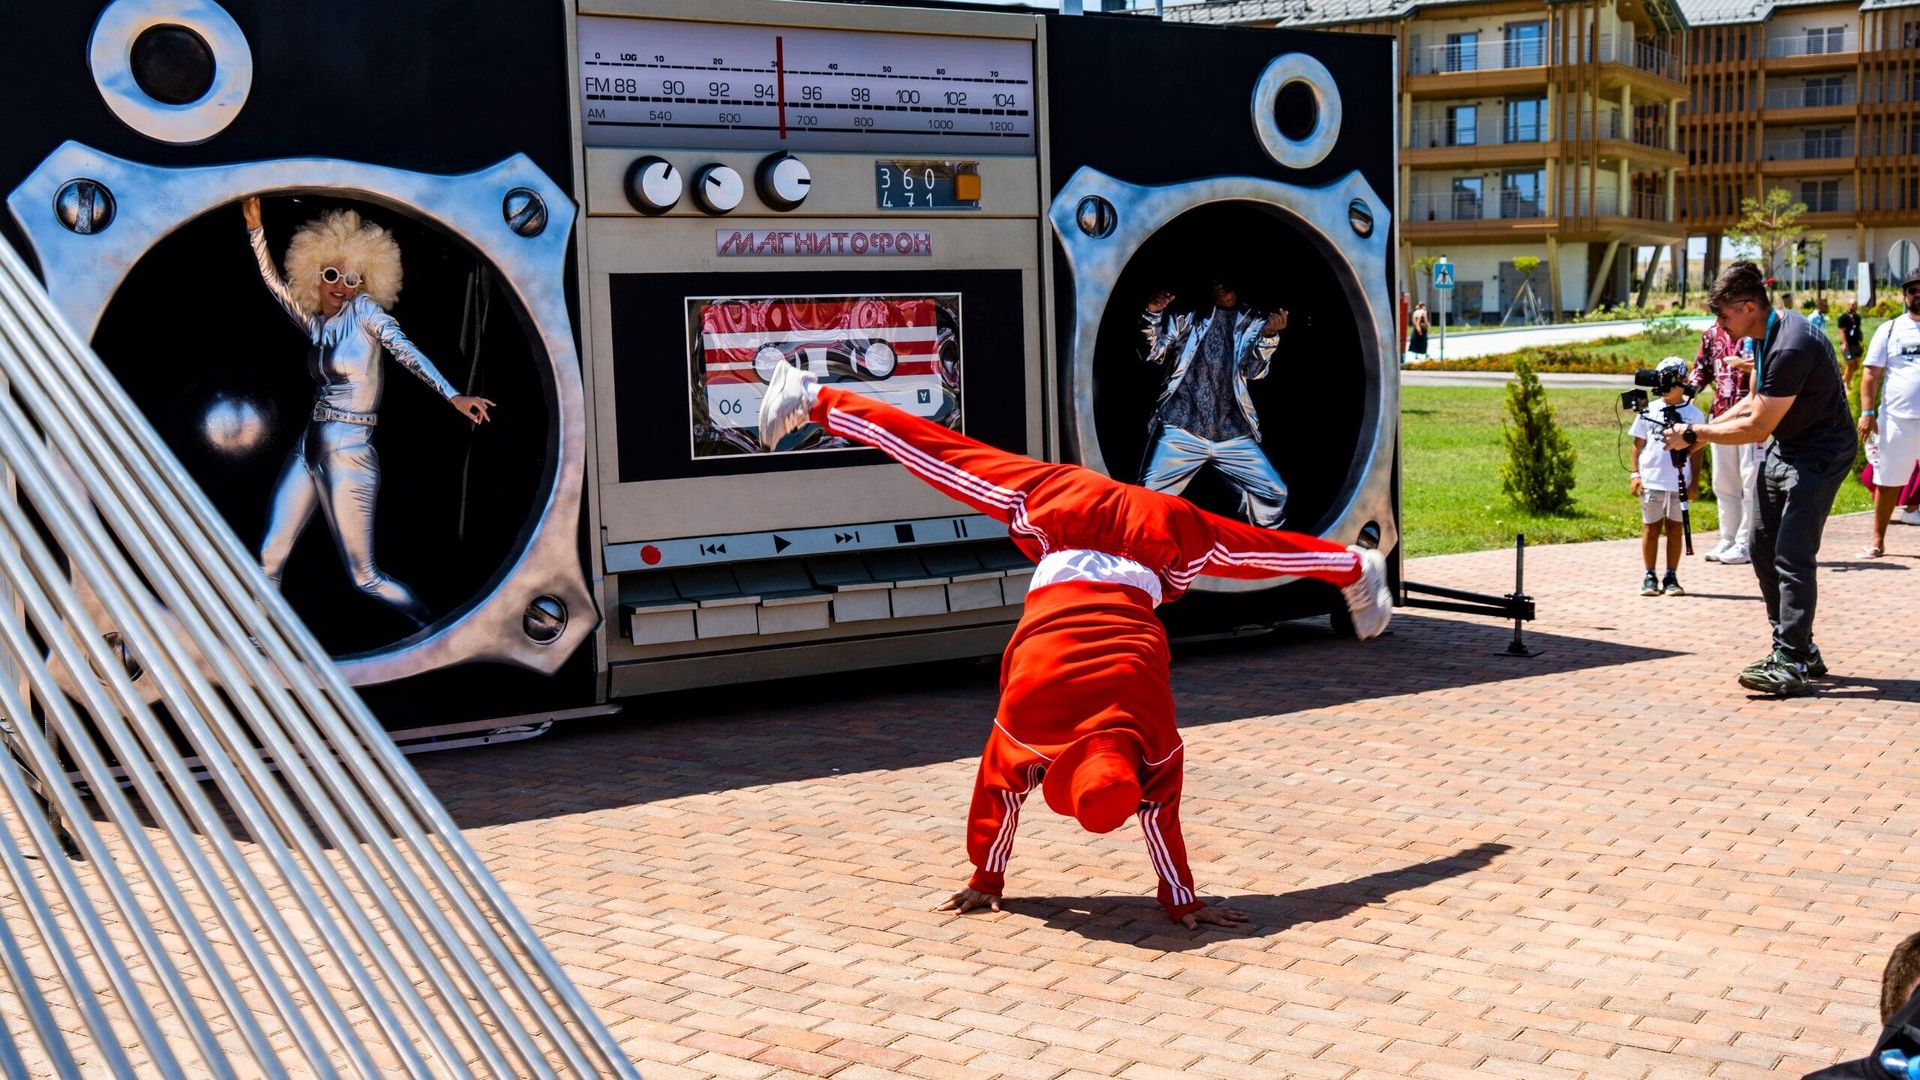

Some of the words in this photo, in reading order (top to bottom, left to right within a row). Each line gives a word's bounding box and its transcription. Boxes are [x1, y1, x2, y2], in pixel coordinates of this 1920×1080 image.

[586, 78, 610, 93] FM
[614, 79, 636, 93] 88
[663, 80, 684, 95] 90
[709, 83, 730, 97] 92
[754, 84, 775, 98] 94
[802, 86, 822, 100] 96
[851, 88, 870, 102] 98
[896, 90, 920, 104] 100
[944, 92, 967, 106] 102
[992, 94, 1015, 107] 104
[587, 109, 605, 119] AM
[650, 111, 672, 121] 540
[719, 113, 740, 123] 600
[797, 115, 818, 126] 700
[854, 117, 874, 127] 800
[928, 120, 953, 129] 1000
[989, 122, 1013, 131] 1200
[720, 231, 931, 255] МАГНИТОФОН
